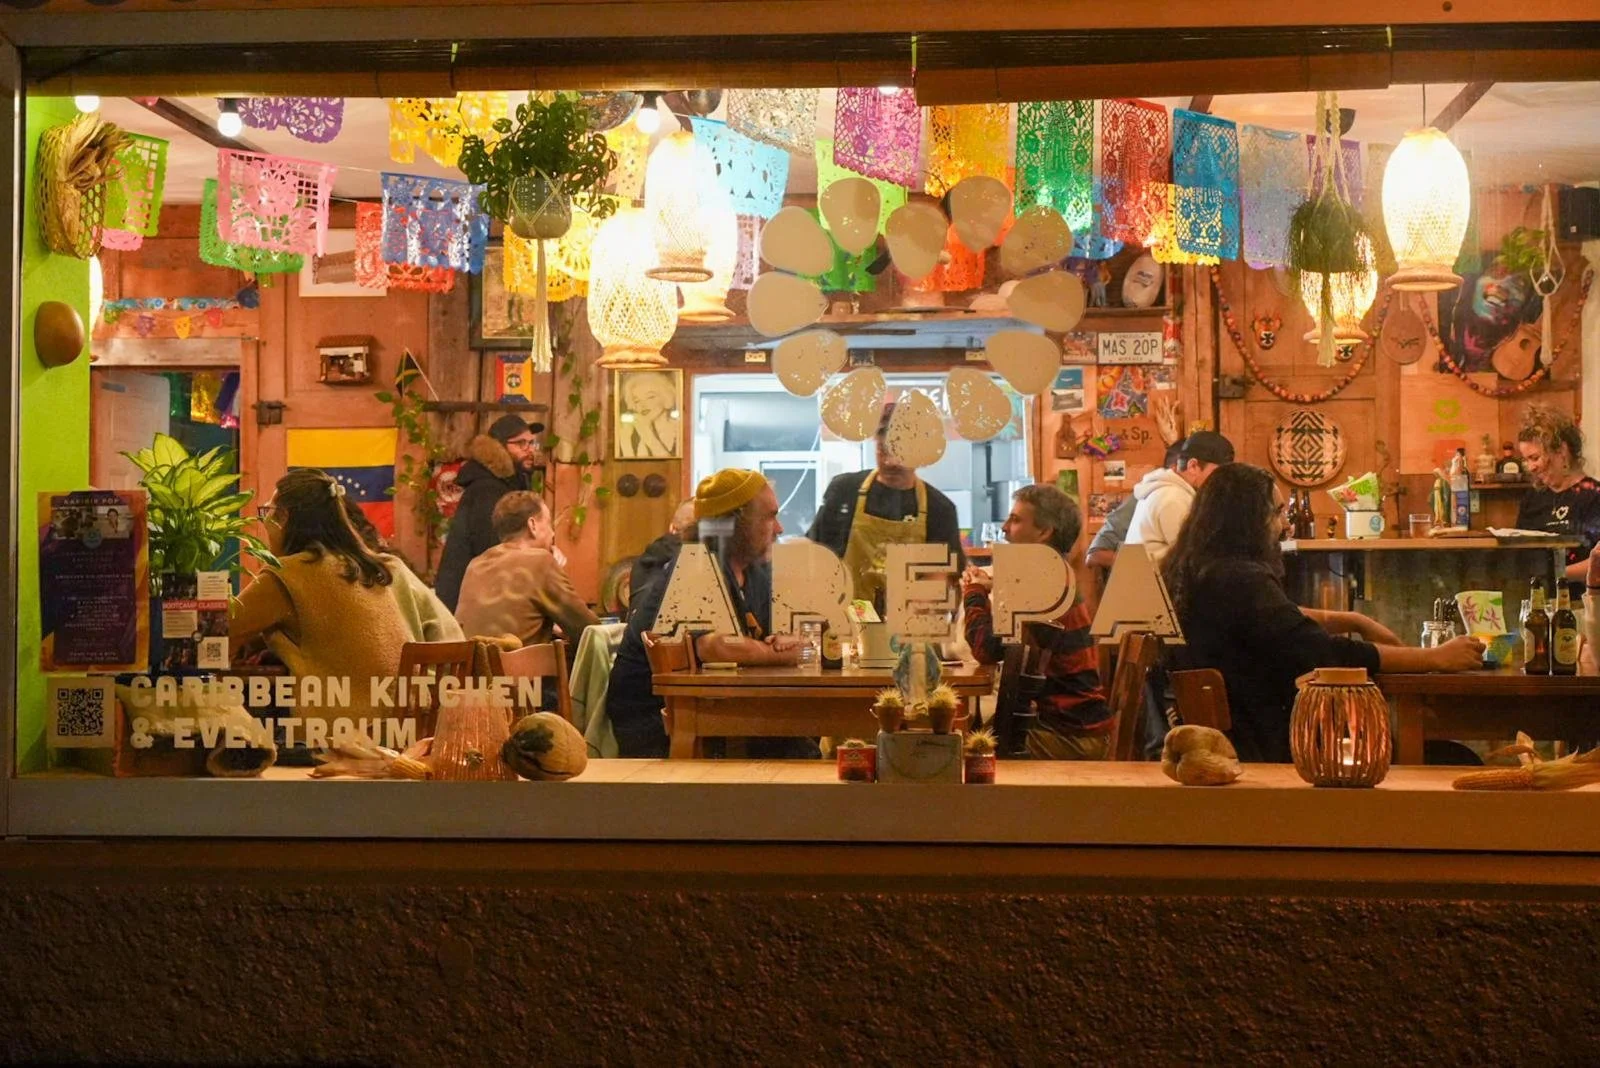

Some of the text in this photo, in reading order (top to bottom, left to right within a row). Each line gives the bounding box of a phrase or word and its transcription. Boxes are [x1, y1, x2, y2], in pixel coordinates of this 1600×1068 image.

[1102, 339, 1127, 356] MAS
[651, 543, 1186, 645] AREPA
[131, 676, 542, 708] CARIBBEAN KITCHEN
[131, 718, 416, 750] & EVENTRAUM
